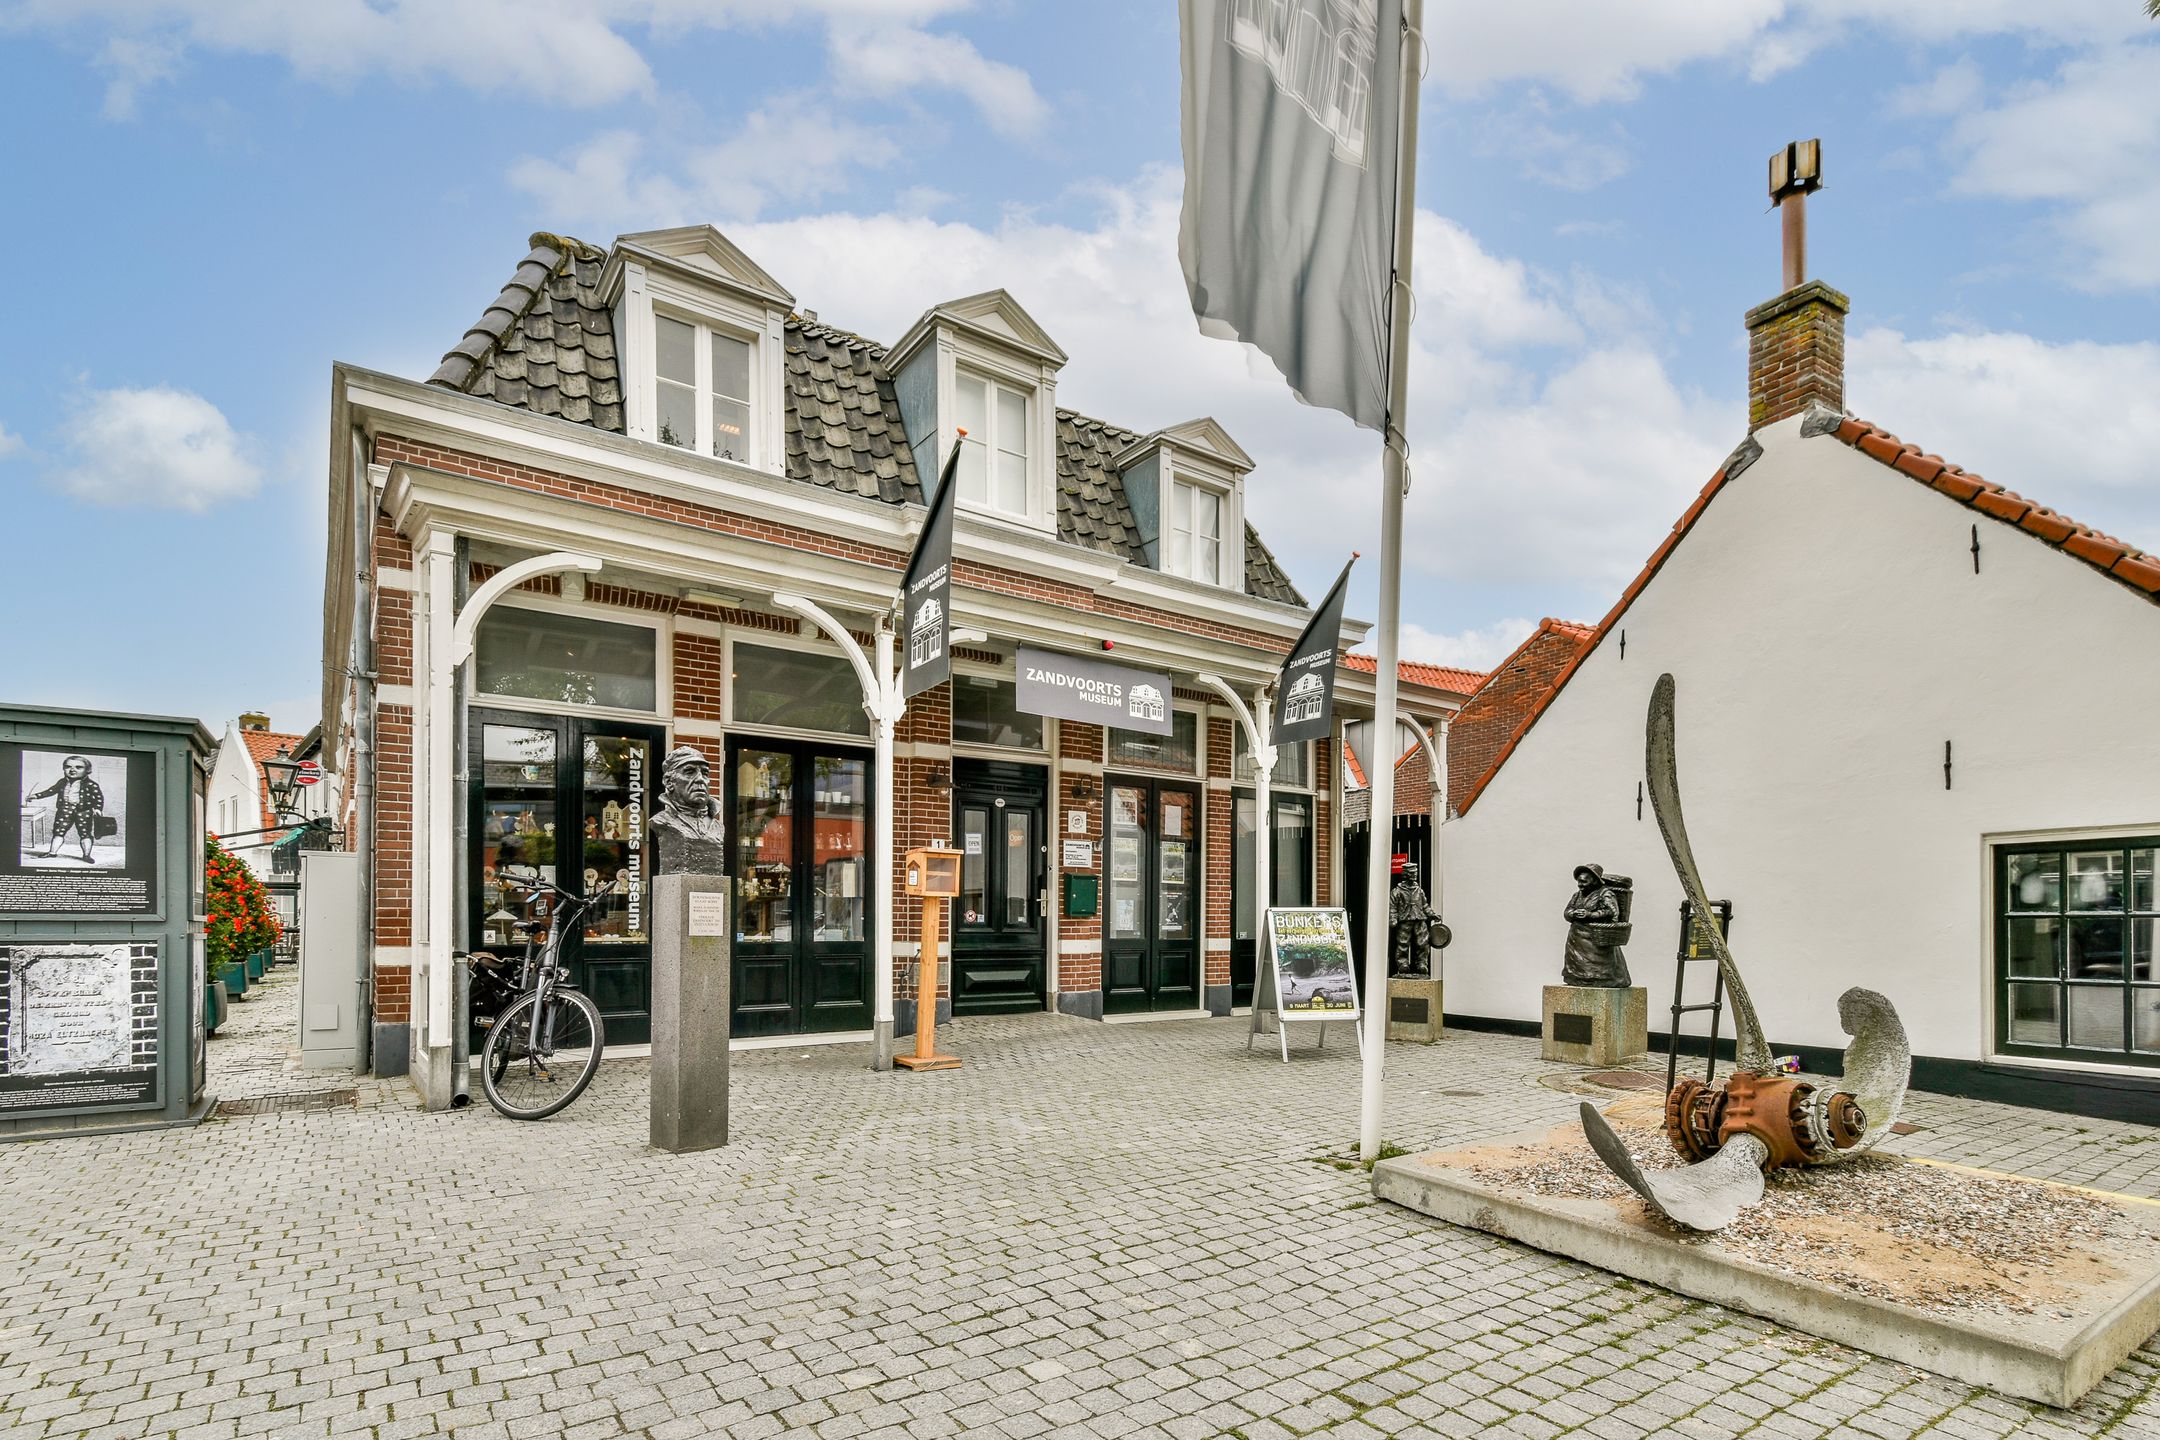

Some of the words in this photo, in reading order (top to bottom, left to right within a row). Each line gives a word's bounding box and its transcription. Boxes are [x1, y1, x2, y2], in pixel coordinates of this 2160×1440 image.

[911, 563, 947, 594] ZANDVOORTS
[1289, 649, 1332, 669] ZANDVOORTS
[1026, 668, 1122, 697] ZANDVOORTS
[1079, 691, 1122, 708] MUSEUM
[629, 747, 644, 850] Zandvoorts
[936, 840, 940, 849] 1
[628, 854, 640, 930] museum
[1276, 916, 1341, 928] BUNKERS
